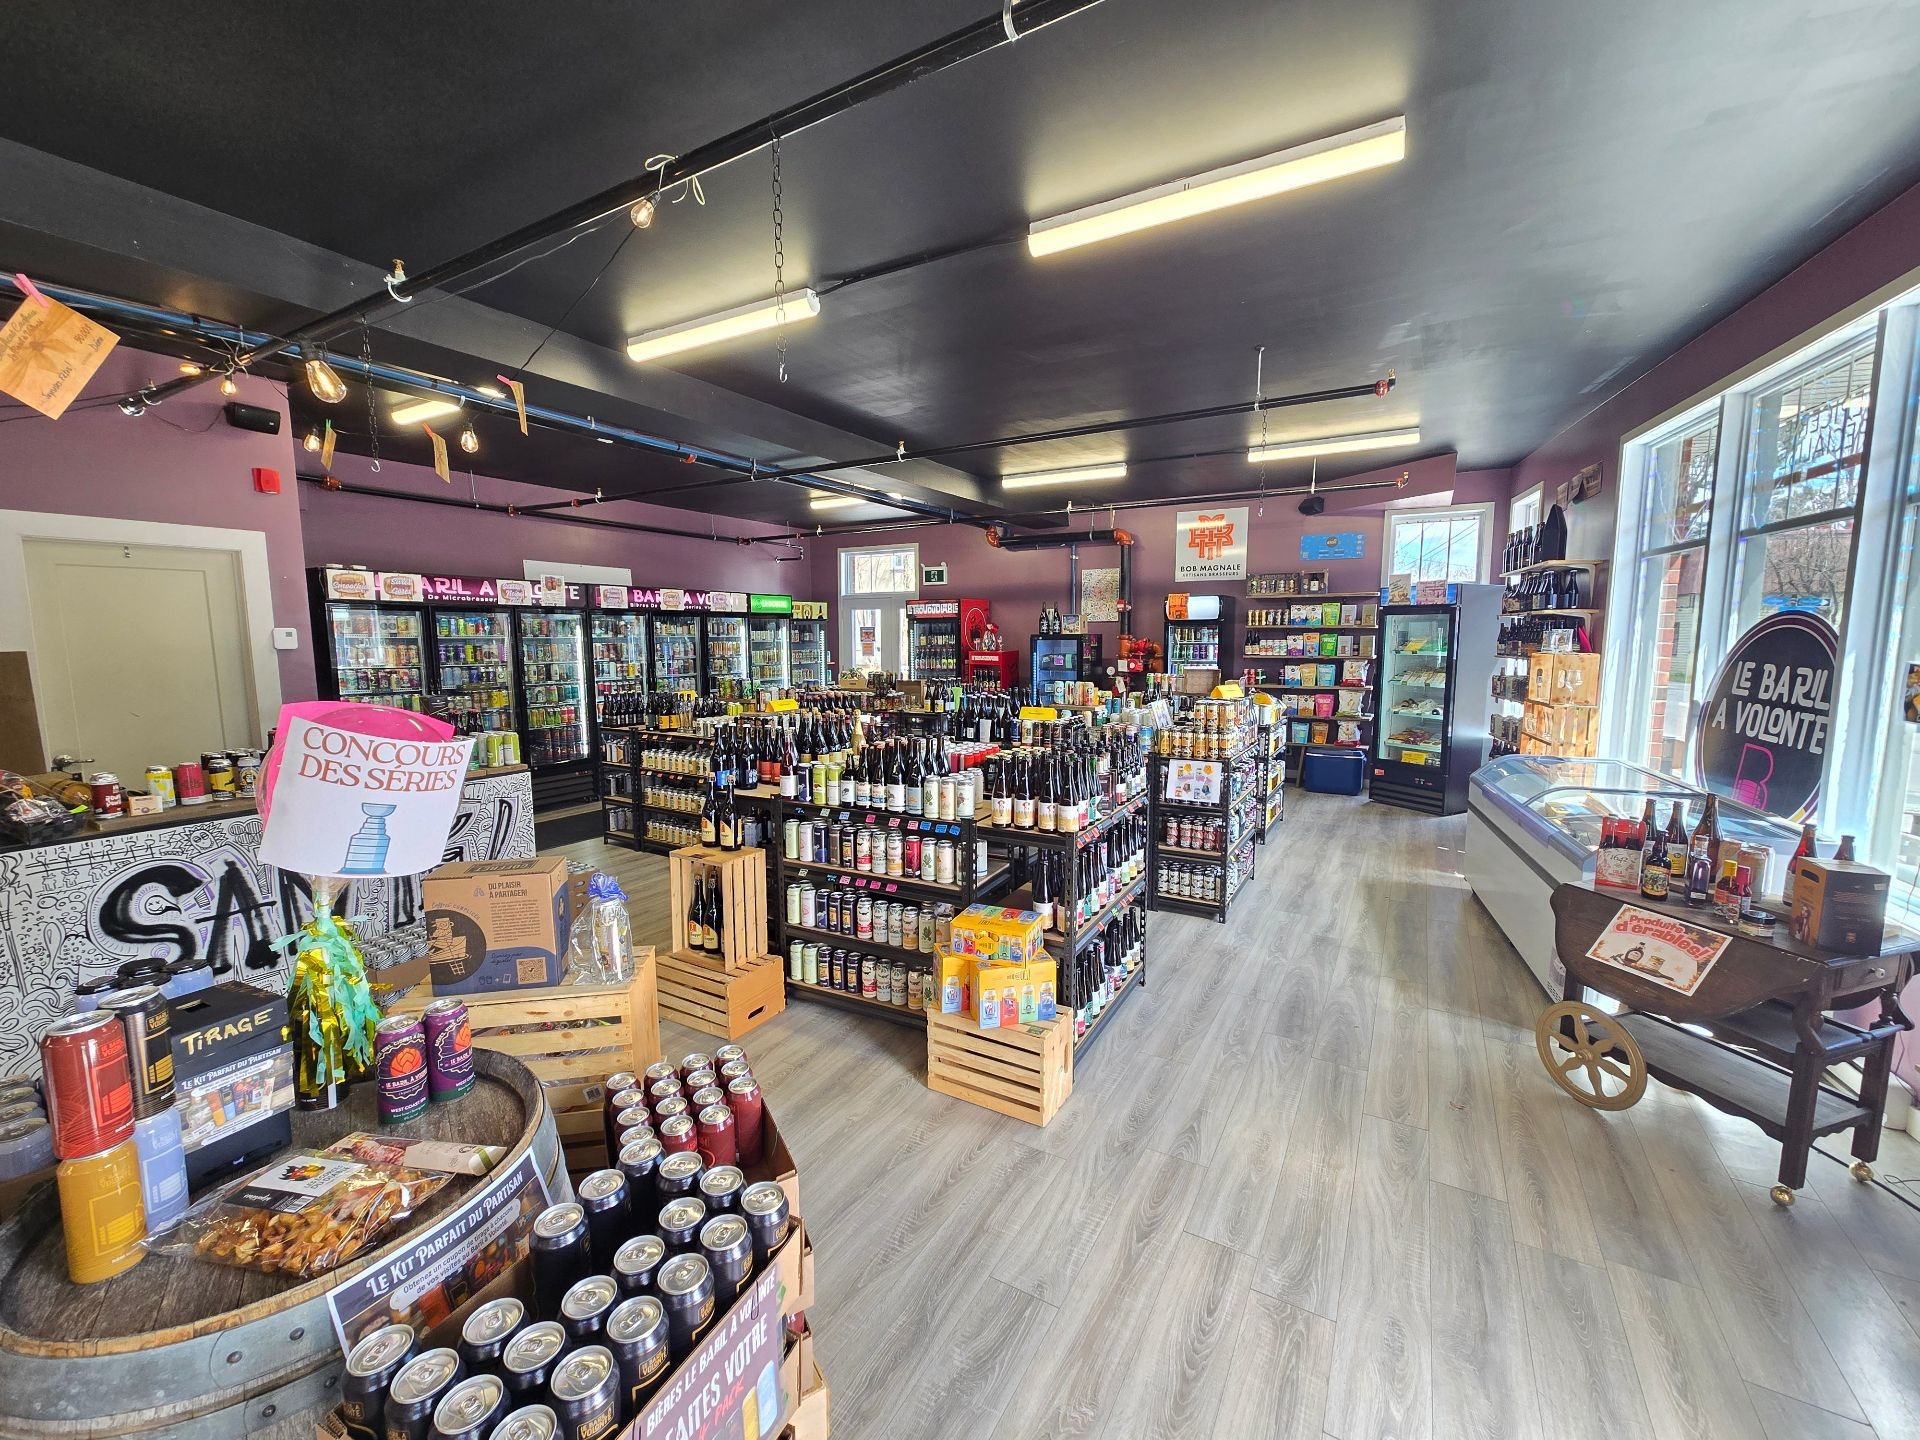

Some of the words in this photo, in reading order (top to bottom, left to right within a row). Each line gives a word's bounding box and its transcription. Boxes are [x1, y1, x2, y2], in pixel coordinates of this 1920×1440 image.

[421, 576, 471, 597] ARIL
[1180, 564, 1198, 573] BOB
[1199, 563, 1241, 573] MAGNALE
[1731, 660, 1757, 697] LE
[1758, 662, 1831, 711] BARIL
[1711, 697, 1728, 731] A
[302, 725, 466, 767] CONCOURS
[297, 752, 361, 787] DES
[363, 763, 458, 793] SÉRIES
[488, 882, 497, 890] DU
[497, 880, 521, 890] PLAISIR
[181, 1080, 193, 1090] LE
[193, 1074, 206, 1085] KIT
[207, 1064, 237, 1081] PARFAIT
[237, 1060, 248, 1068] DU
[248, 1048, 282, 1063] PARTISAN
[366, 1270, 390, 1297] LE
[389, 1257, 415, 1284] KIT
[415, 1221, 468, 1267] PARFAIT
[468, 1208, 485, 1228] DU
[483, 1170, 524, 1216] PARTISAN
[403, 1271, 433, 1294] Obtenez
[432, 1262, 443, 1274] un
[443, 1246, 467, 1272] coupon
[466, 1238, 475, 1251] de
[474, 1226, 491, 1248] tirage
[416, 1282, 428, 1295] de
[427, 1273, 440, 1287] vos
[439, 1257, 462, 1279] visites
[461, 1250, 471, 1263] au
[470, 1238, 485, 1255] Baril
[724, 1312, 768, 1384] VOTRE
[646, 1380, 683, 1437] BIÈRES
[684, 1364, 697, 1393] LE
[699, 1334, 728, 1374] BARIL
[729, 1314, 737, 1337] À
[714, 1375, 745, 1426] PACK
